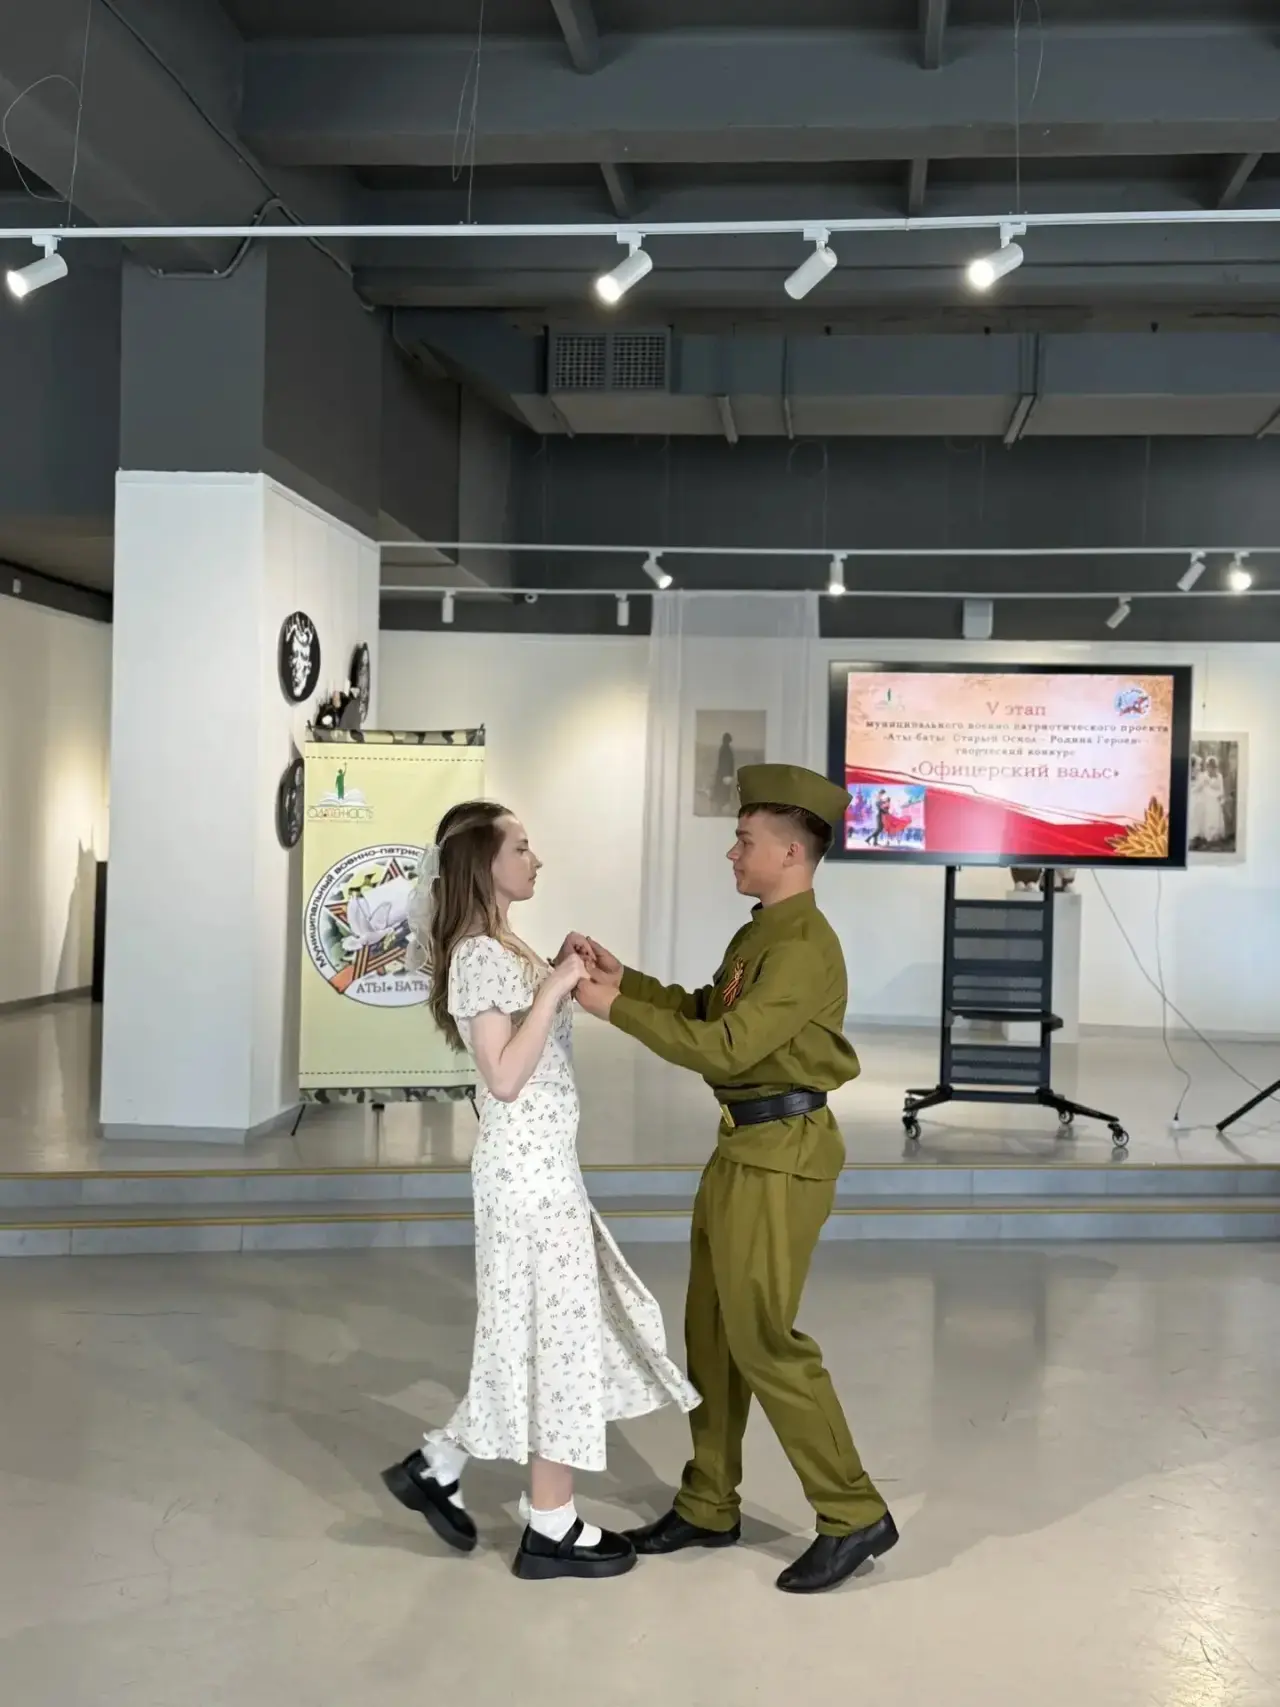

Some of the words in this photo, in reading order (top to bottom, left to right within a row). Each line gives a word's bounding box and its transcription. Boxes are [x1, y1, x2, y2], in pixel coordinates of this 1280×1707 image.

[986, 701, 1000, 716] V
[1004, 705, 1046, 717] этап
[1120, 724, 1169, 734] проекта
[1050, 735, 1092, 745] Родина
[911, 761, 1050, 780] «Офицерский
[1057, 766, 1120, 779] вальс»
[307, 874, 334, 969] Муниципальный
